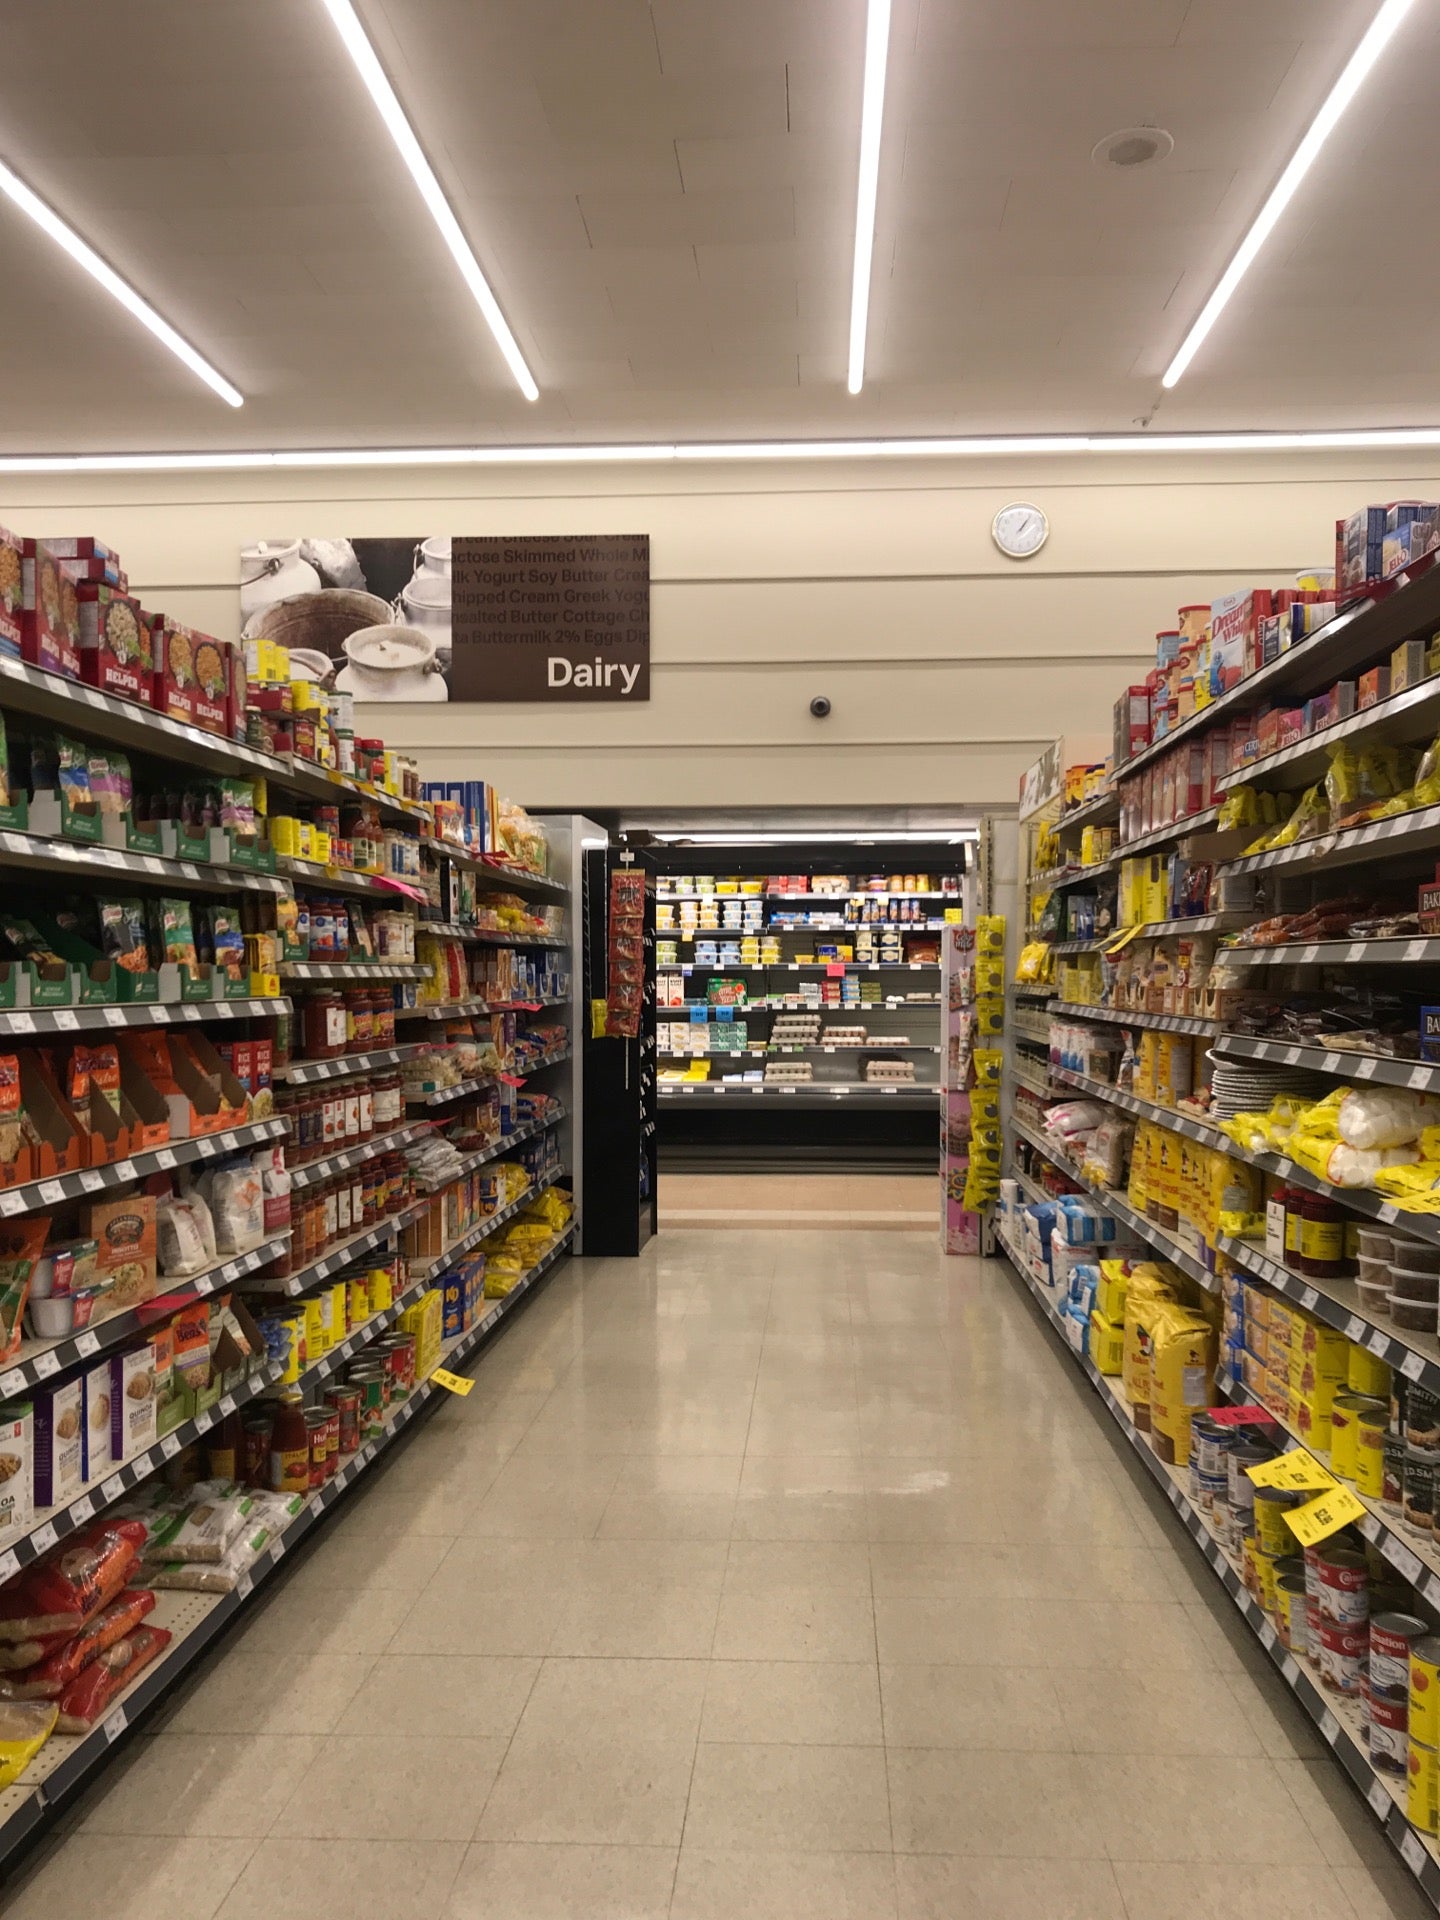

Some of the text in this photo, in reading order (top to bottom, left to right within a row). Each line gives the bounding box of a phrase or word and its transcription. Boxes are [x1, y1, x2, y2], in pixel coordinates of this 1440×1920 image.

[504, 549, 575, 563] Skimmed
[580, 548, 629, 561] Whole
[473, 570, 525, 587] Yogurt
[528, 569, 557, 586] Soy
[562, 568, 607, 582] Butter
[510, 589, 560, 603] Cream
[564, 589, 610, 603] Greek
[511, 609, 558, 623] Butter
[563, 609, 626, 626] Cottage
[1211, 604, 1244, 640] Dream
[472, 630, 552, 643] Buttermilk
[555, 630, 580, 643] 2%
[585, 629, 622, 646] Eggs
[106, 668, 138, 690] HELPER
[548, 656, 641, 694] Dairy
[168, 692, 191, 711] HELPER
[197, 703, 224, 722] HELPER
[129, 1404, 152, 1419] QUINOA
